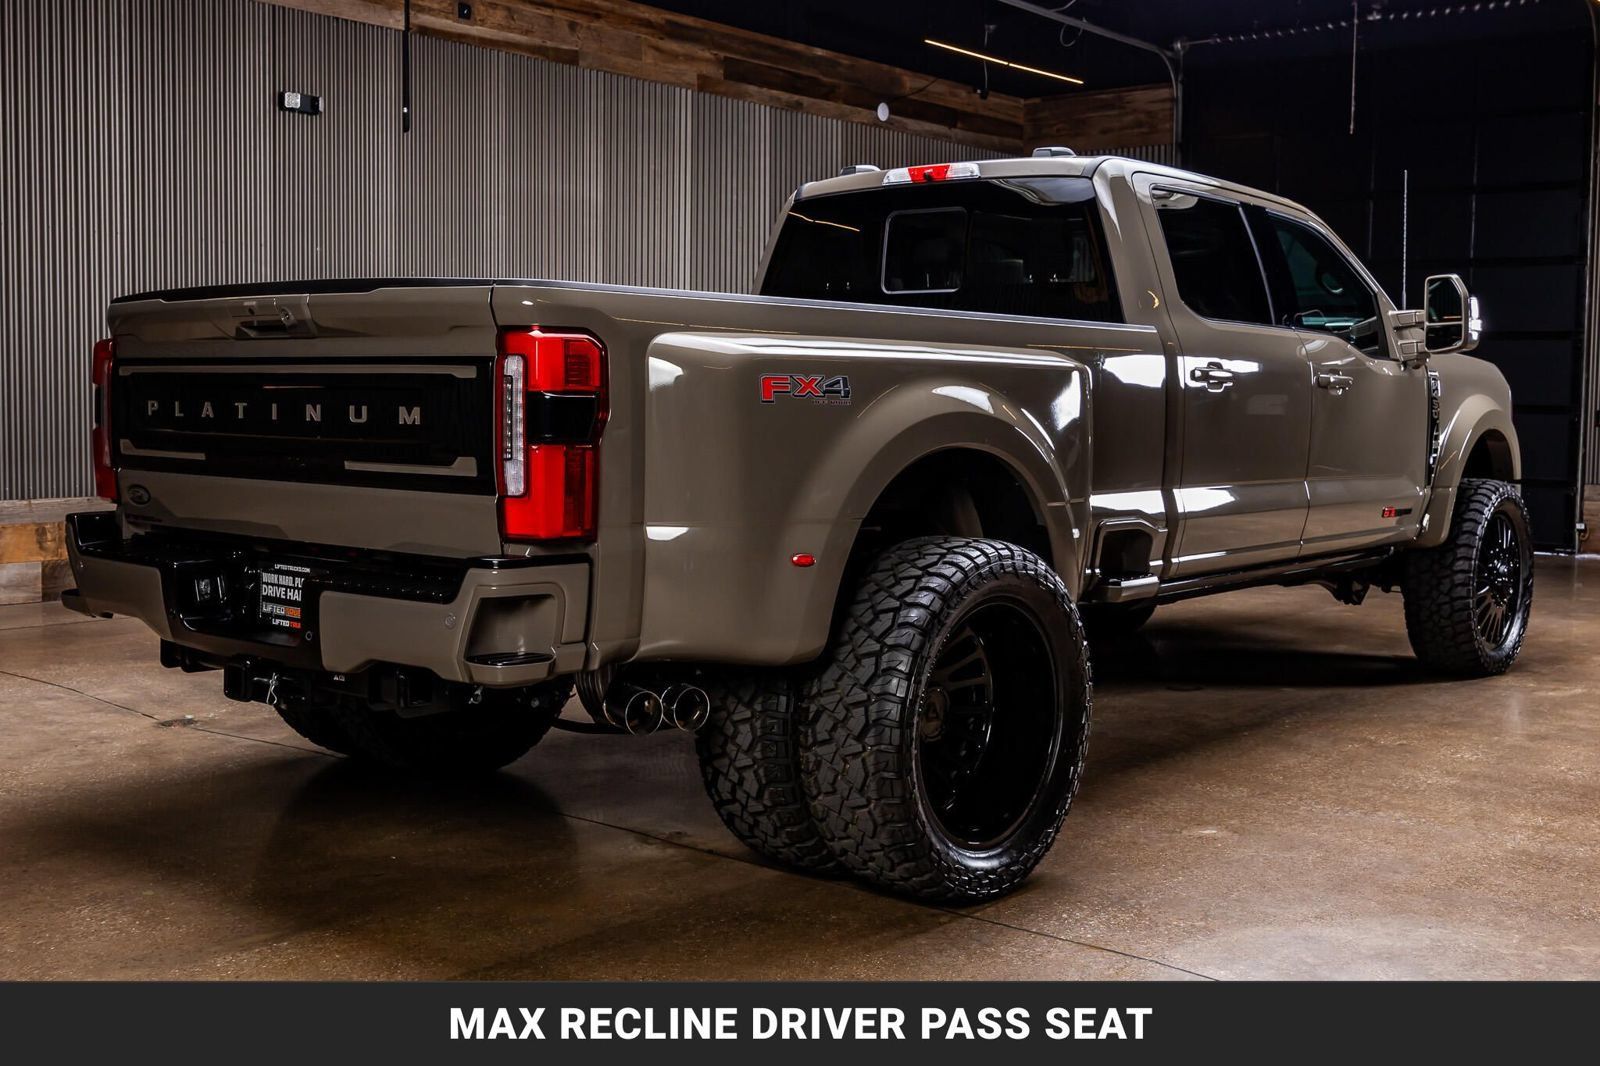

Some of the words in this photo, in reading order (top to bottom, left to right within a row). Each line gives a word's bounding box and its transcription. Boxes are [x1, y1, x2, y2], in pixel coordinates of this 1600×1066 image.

[760, 374, 851, 404] FX4
[147, 400, 421, 425] PLATINUM
[262, 572, 278, 585] WORK
[262, 584, 286, 599] DRIVE
[262, 602, 285, 615] LIFTED
[272, 618, 290, 627] LIFTED
